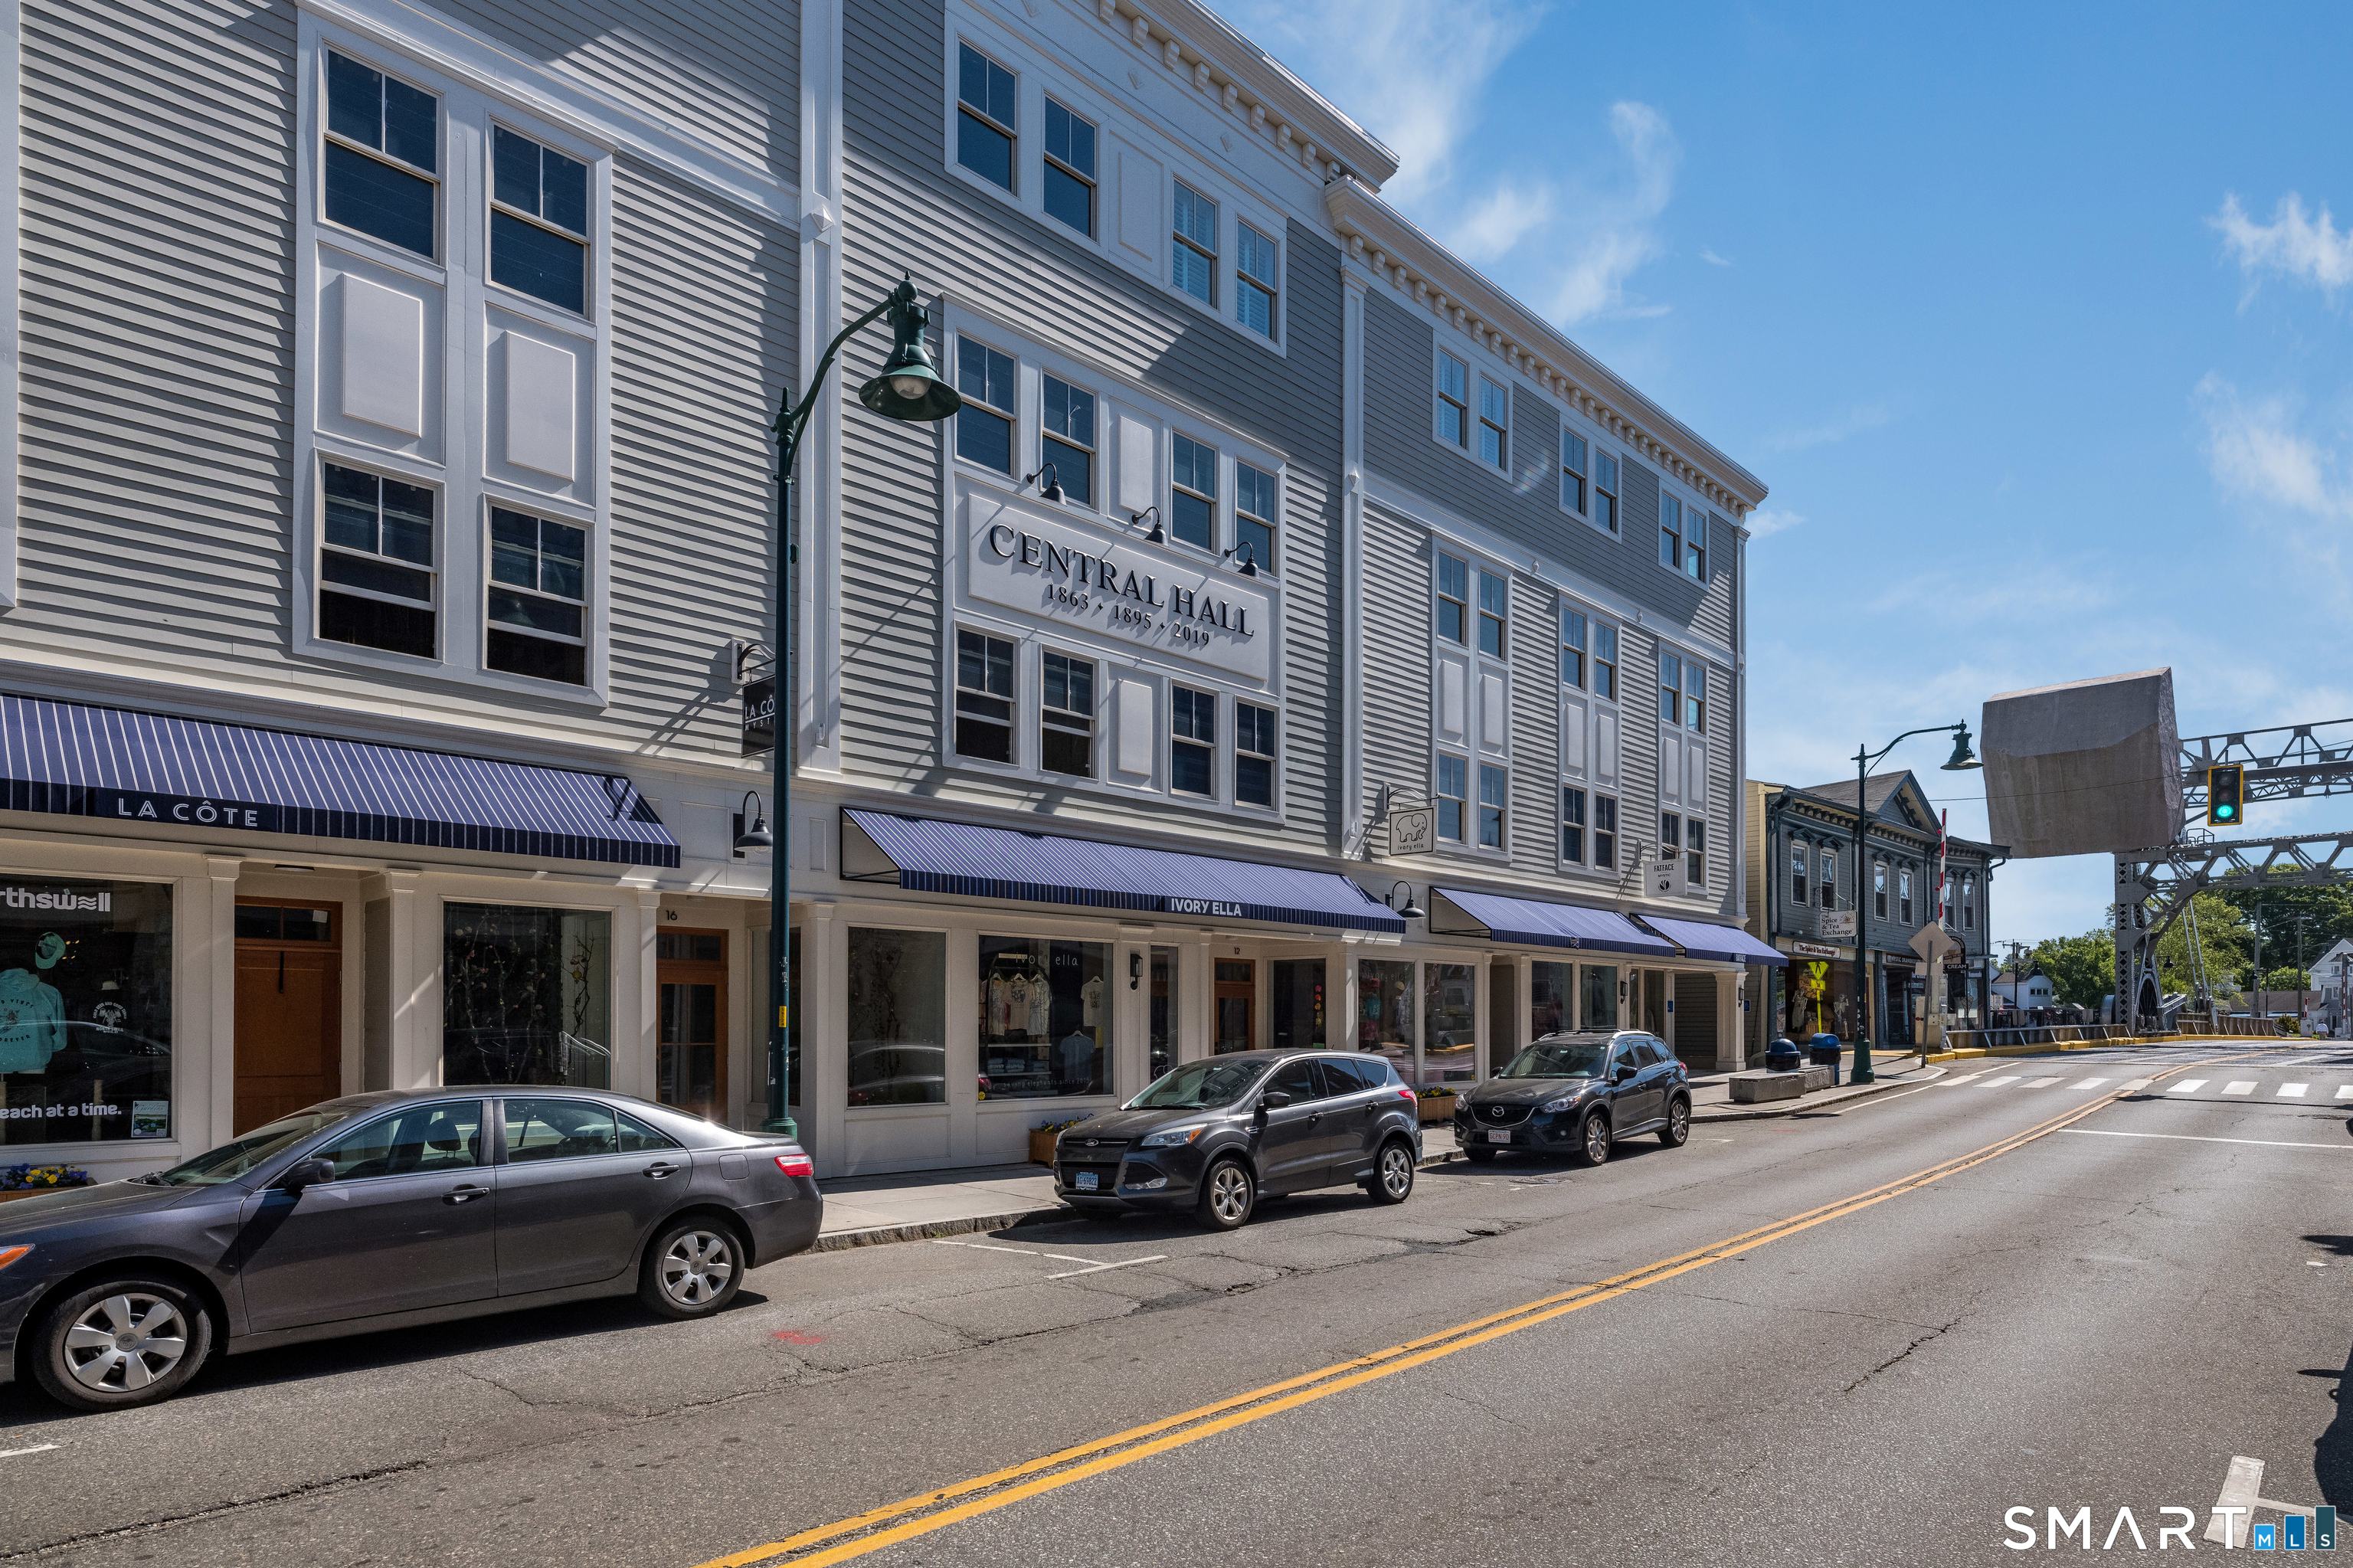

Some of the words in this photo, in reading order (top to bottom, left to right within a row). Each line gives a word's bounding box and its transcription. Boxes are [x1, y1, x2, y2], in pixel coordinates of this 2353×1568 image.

[990, 524, 1164, 608] CENTRAL
[1173, 584, 1255, 637] HALL
[1048, 583, 1089, 611] 1863
[1114, 604, 1153, 630] 1895
[1173, 623, 1210, 647] 2019
[745, 704, 756, 720] LA
[761, 694, 775, 715] CÔ
[745, 718, 771, 732] MYST
[118, 797, 158, 818] LA
[173, 800, 258, 827] CÔTE
[1654, 863, 1674, 872] FATFACE
[1171, 898, 1209, 914] IVORY
[1212, 902, 1242, 916] ELLA
[666, 910, 678, 921] 16
[1821, 948, 1835, 957] Exchange
[1055, 954, 1078, 967] ella
[1367, 972, 1388, 982] ivory
[1391, 971, 1405, 980] ella
[46, 1104, 64, 1118] at
[67, 1105, 78, 1117] a
[81, 1102, 122, 1116] time.
